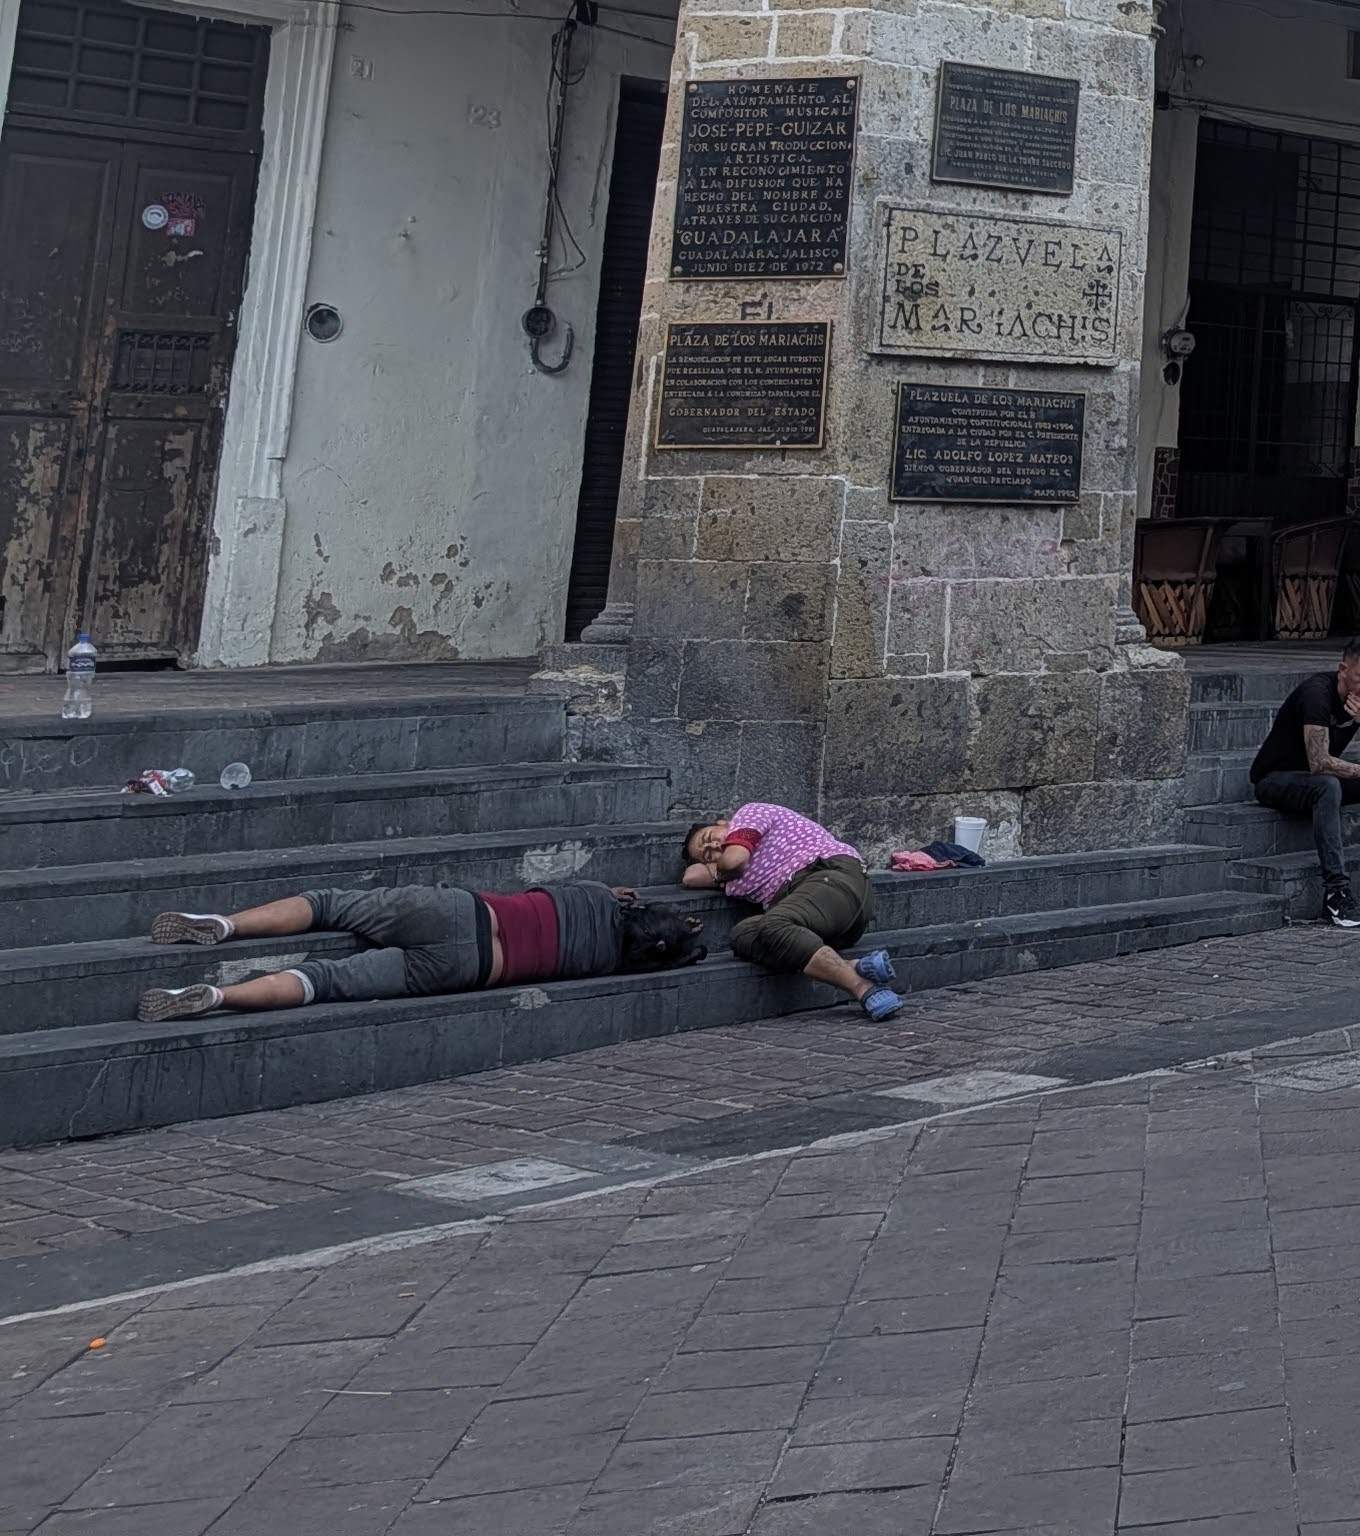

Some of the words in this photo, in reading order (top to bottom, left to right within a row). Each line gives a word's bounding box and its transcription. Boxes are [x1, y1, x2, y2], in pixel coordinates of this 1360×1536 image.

[728, 83, 819, 95] HOMENAJE
[691, 108, 768, 119] COMPOSITOR
[786, 106, 850, 117] MUSICAL
[950, 96, 977, 112] PLAZA
[983, 100, 994, 115] DE
[1000, 102, 1016, 117] LOS
[1022, 105, 1068, 124] MARIACHIS
[687, 143, 709, 152] POR
[714, 142, 728, 152] SU
[730, 141, 766, 152] GRAN
[684, 167, 692, 177] Y
[700, 166, 717, 176] EN
[685, 180, 694, 189] A
[701, 180, 718, 189] LA
[726, 179, 785, 188] DIFUSION
[792, 178, 818, 187] QUE
[826, 177, 844, 187] HA
[684, 192, 724, 202] HECHO
[731, 191, 754, 201] DEL
[763, 190, 818, 200] NOMBRE
[825, 189, 844, 199] DE
[697, 203, 757, 213] NUESTRA
[745, 215, 760, 224] DE
[763, 215, 778, 224] SU
[780, 213, 842, 223] CANCION
[782, 249, 839, 258] JALISCO
[691, 262, 728, 272] JUNIO
[734, 262, 765, 272] DIEZ
[772, 262, 788, 271] DE
[795, 261, 824, 271] 1972
[896, 263, 925, 279] DE
[895, 280, 939, 297] LOS
[888, 302, 1111, 343] MARIACHIS
[670, 334, 709, 347] PLAZA
[714, 334, 729, 346] DE
[733, 333, 756, 346] LOS
[759, 333, 824, 346] MARIACHIS
[909, 391, 969, 404] PLAZUELA
[974, 394, 987, 404] DE
[992, 395, 1012, 406] LOS
[1017, 396, 1076, 409] MARIACHIS
[669, 407, 740, 417] GOBERNADOR
[748, 407, 766, 417] DEL
[774, 407, 816, 417] ESTADO
[908, 416, 968, 426] AYUNTAMIENTO
[969, 419, 1032, 429] CONSTITUCIONAL
[901, 425, 945, 435] ENTREGADA
[969, 429, 996, 437] CIUDAD
[934, 450, 982, 461] ADOLFO
[988, 452, 1023, 463] LOPEZ
[1029, 453, 1073, 464] MATEOS
[939, 466, 992, 474] GOBERNADOR
[990, 477, 1031, 485] PRECIADO
